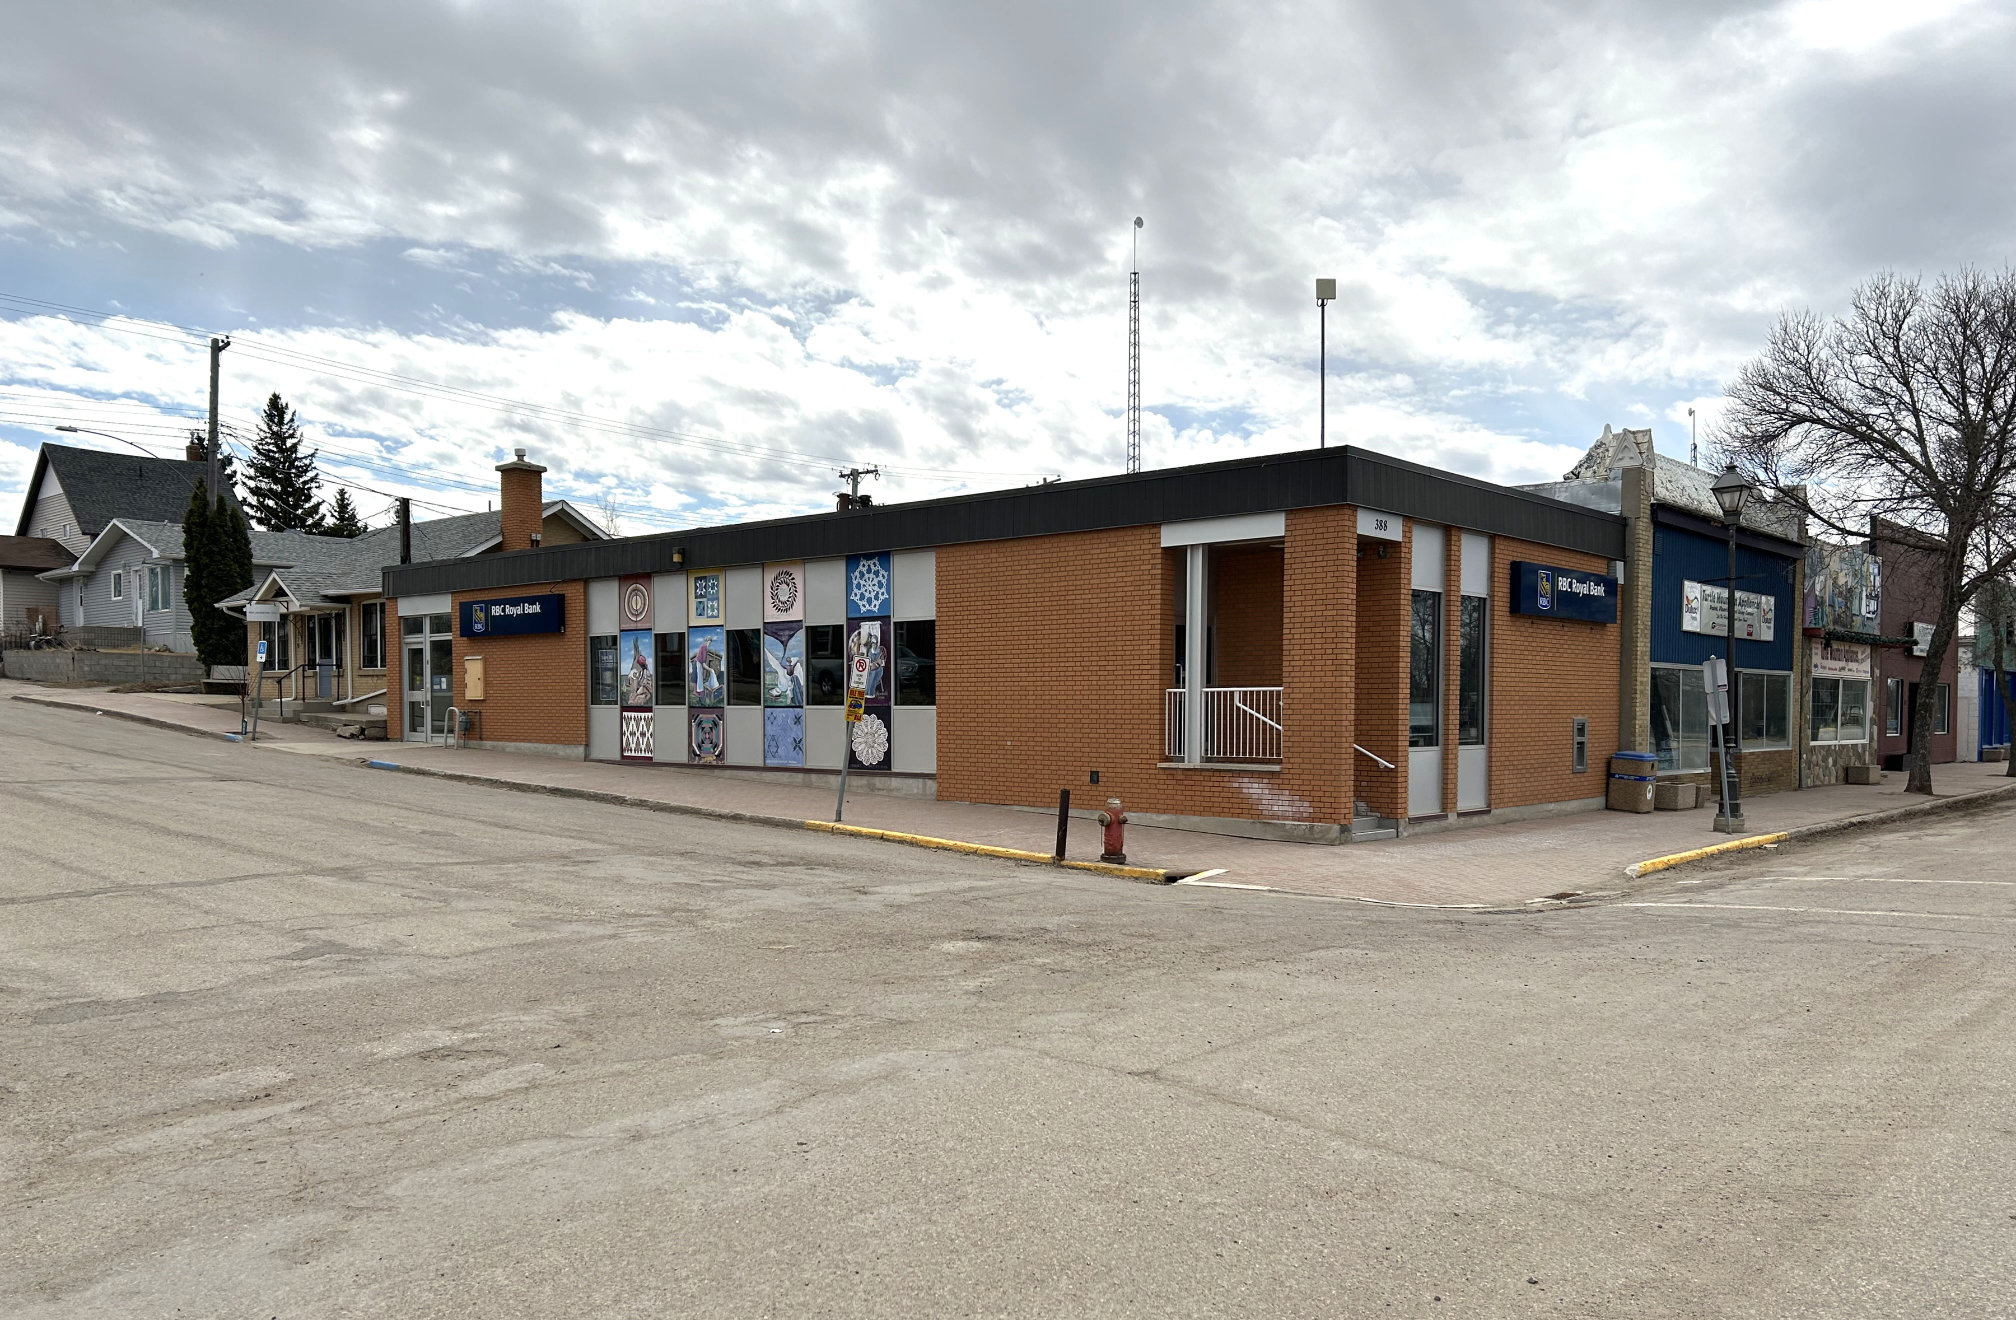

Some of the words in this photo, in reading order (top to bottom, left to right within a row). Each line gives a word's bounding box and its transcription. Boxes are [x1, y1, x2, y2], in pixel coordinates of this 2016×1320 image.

[1374, 518, 1388, 532] 388
[1558, 576, 1572, 592] RBC
[1572, 579, 1589, 598] Royal
[1590, 581, 1605, 597] Bank
[1539, 597, 1550, 607] RBC
[1702, 589, 1716, 603] Turtle
[491, 605, 505, 616] RBC
[505, 603, 523, 617] Royal
[524, 601, 541, 614] Bank
